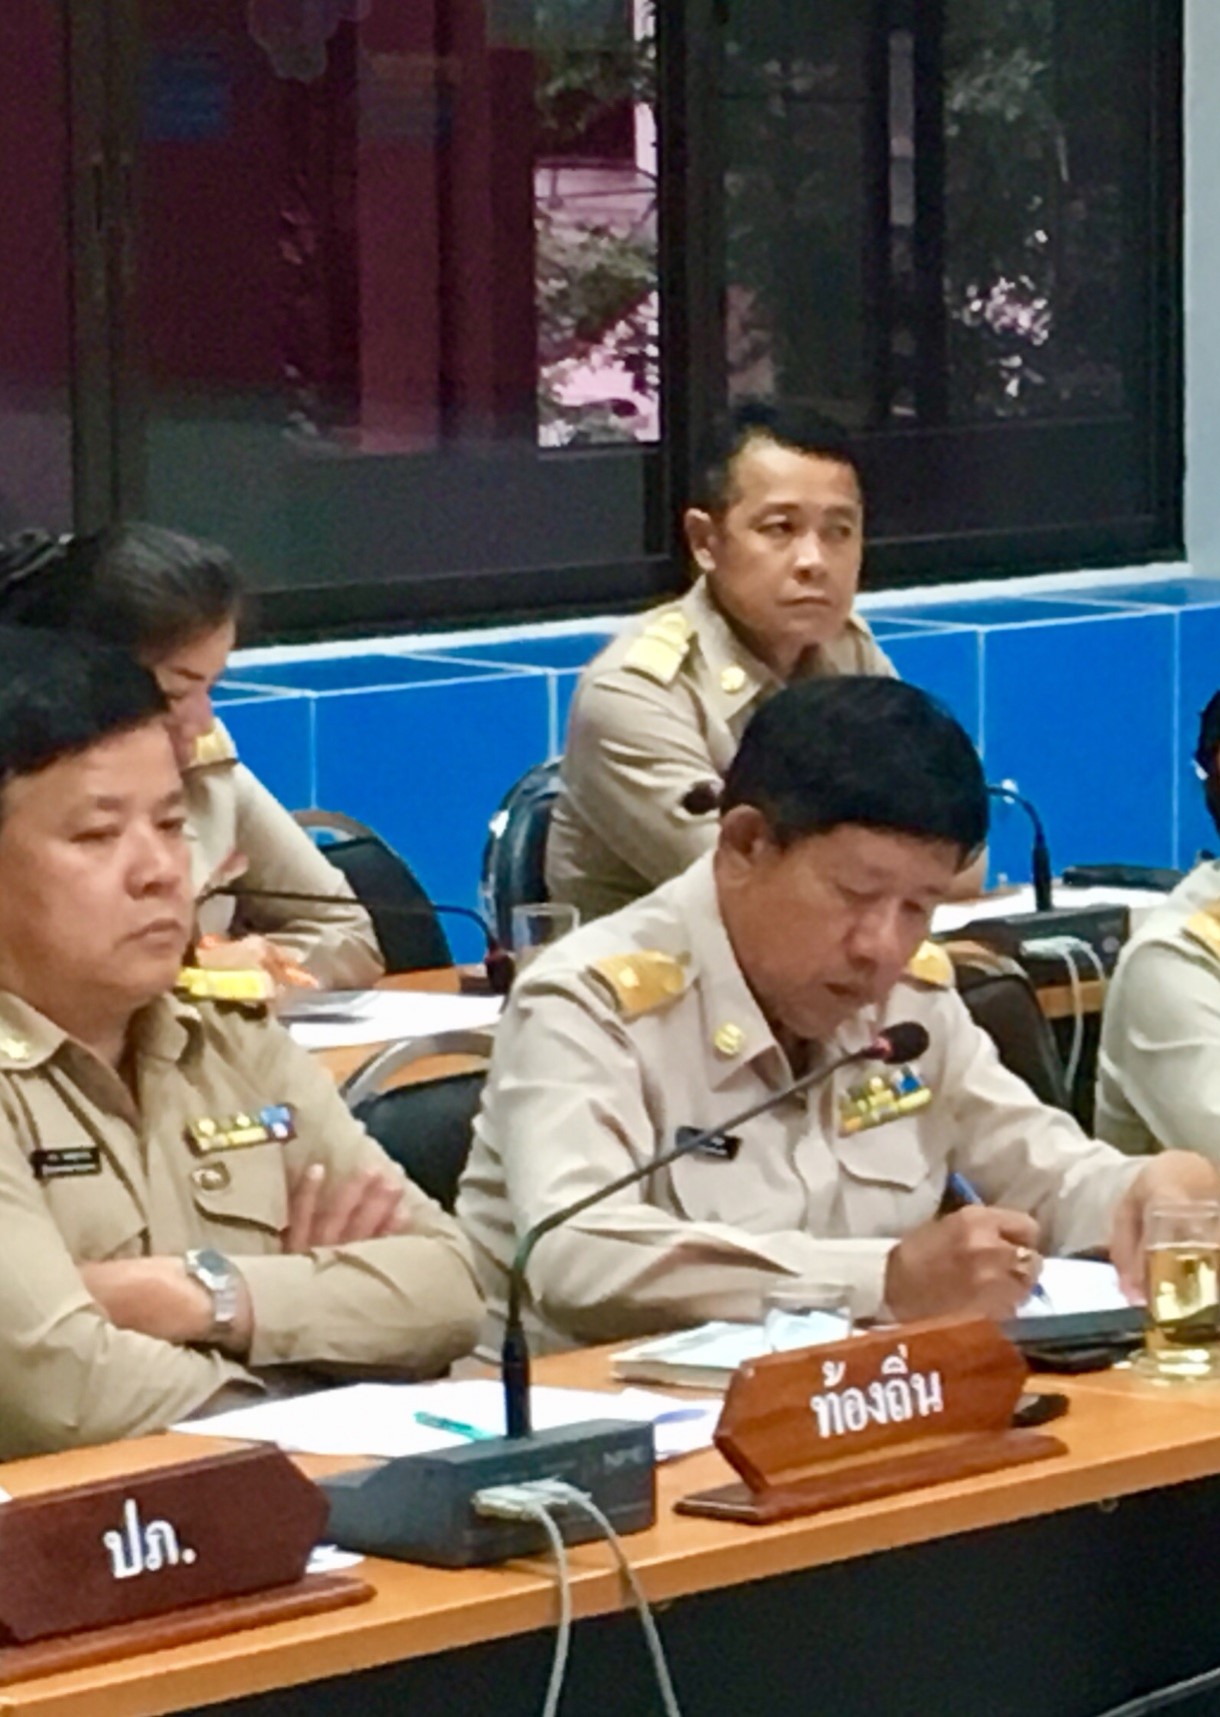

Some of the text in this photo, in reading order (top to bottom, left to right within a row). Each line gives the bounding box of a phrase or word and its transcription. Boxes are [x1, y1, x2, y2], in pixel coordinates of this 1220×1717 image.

[810, 1342, 944, 1439] ท้องถิ่น
[103, 1497, 197, 1580] ปภ.
